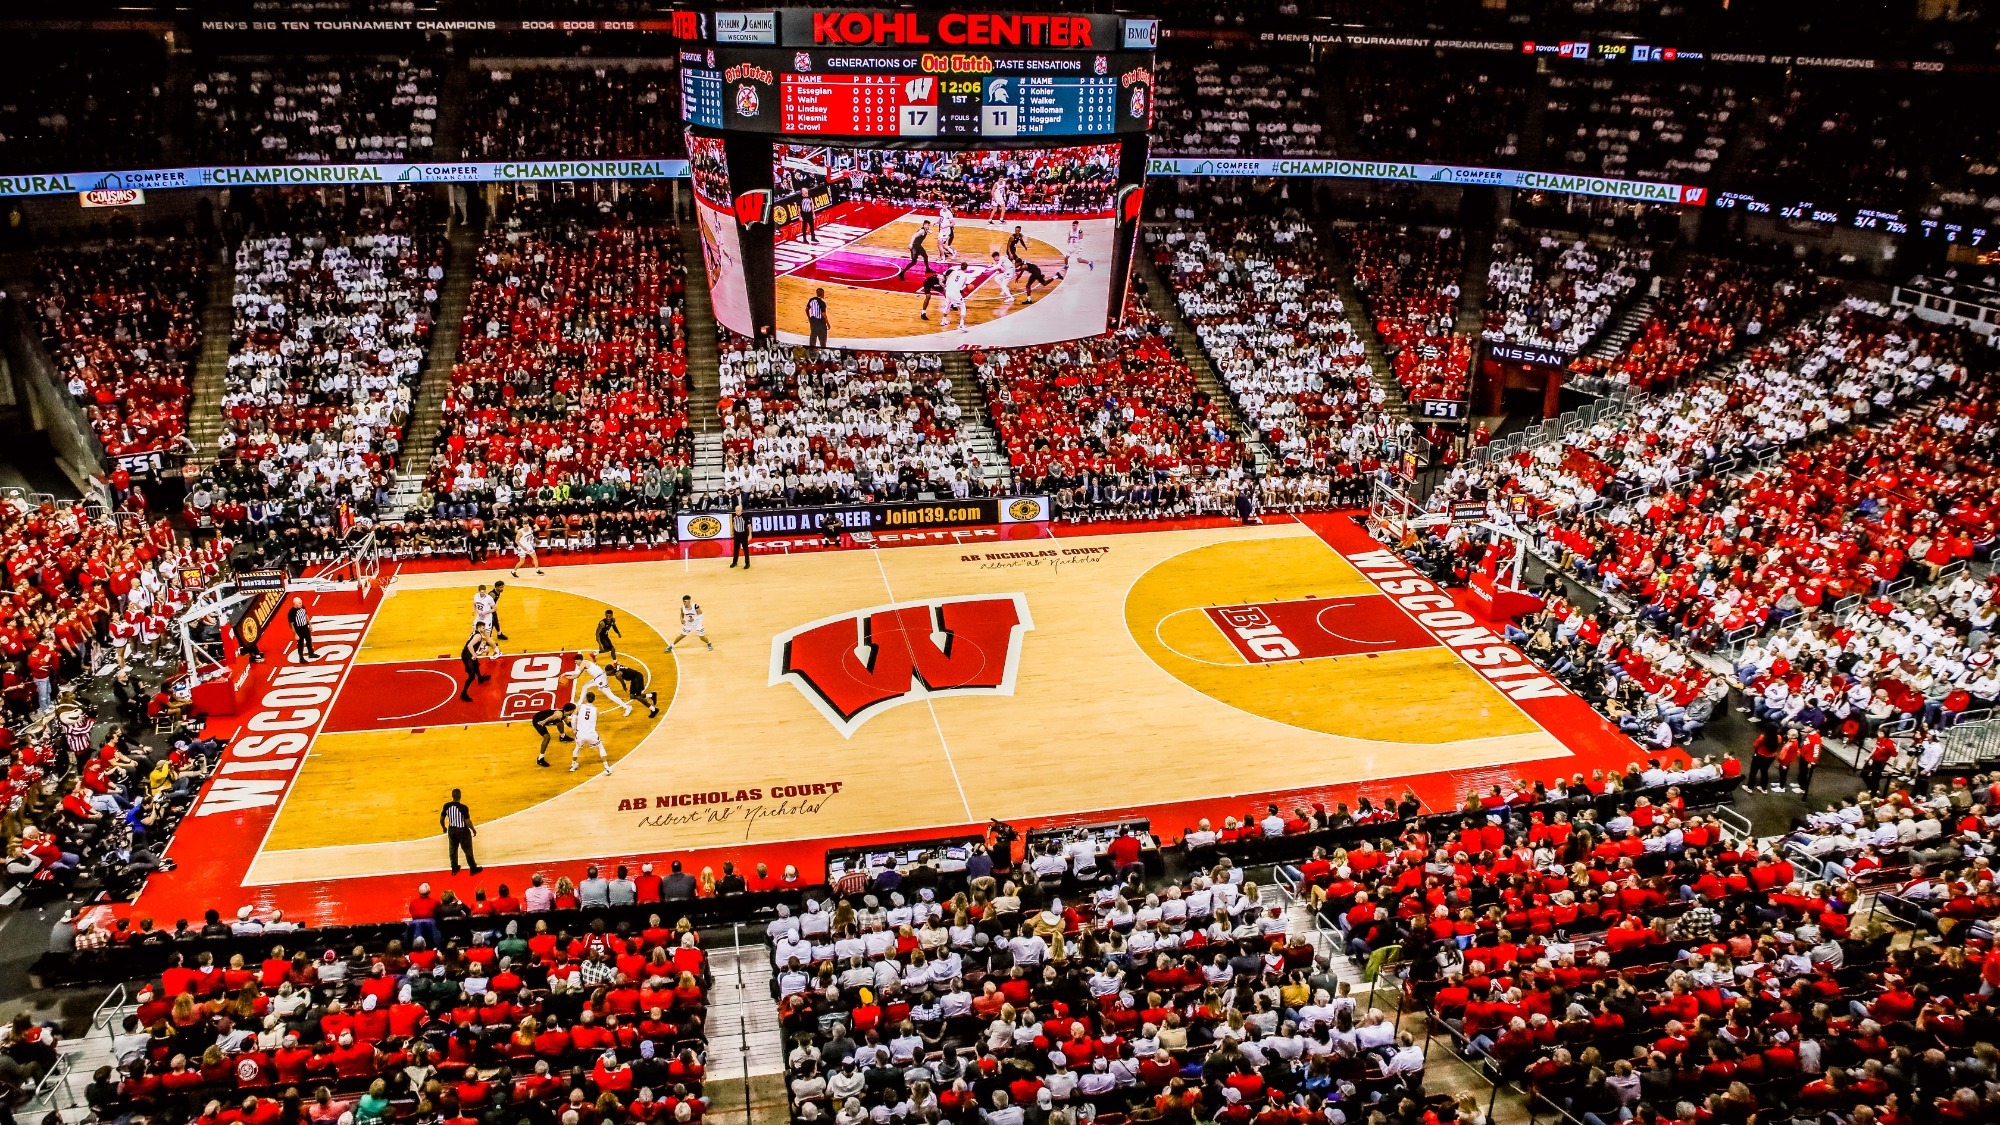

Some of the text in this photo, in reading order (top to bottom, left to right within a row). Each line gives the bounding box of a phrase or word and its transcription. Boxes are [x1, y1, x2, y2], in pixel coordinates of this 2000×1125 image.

[202, 21, 248, 30] MEN'S
[253, 21, 277, 30] BIG
[281, 21, 309, 30] TEN
[314, 21, 412, 30] TOURNAMENT
[416, 21, 496, 30] CHAMPIONS
[522, 21, 554, 30] 2004
[605, 21, 634, 30] 2015
[749, 19, 772, 30] GAMING
[814, 12, 1092, 47] KOHL CENTER
[1128, 27, 1148, 40] BMO
[1278, 33, 1309, 42] MEN'S
[1312, 34, 1342, 43] NCAA
[1347, 36, 1430, 47] TOURNAMENT
[1434, 40, 1514, 50] APPEARANCES
[1575, 46, 1587, 55] 17
[1598, 44, 1626, 54] 12:06
[1637, 48, 1647, 57] 11
[827, 58, 900, 69] GENERATIONS
[903, 58, 917, 68] OF
[995, 60, 1026, 70] TASTE
[1027, 60, 1081, 70] SENSATIONS
[1710, 53, 1766, 63] WOMEN'S
[1796, 57, 1875, 69] CHAMPIONS
[797, 75, 822, 83] NAME
[1031, 77, 1053, 85] NAME
[940, 82, 981, 93] 12:06
[1030, 87, 1054, 95] Kohler
[797, 96, 818, 104] Wahl
[1030, 97, 1056, 105] Walker
[797, 105, 828, 114] Lindsey
[1030, 106, 1064, 114] Holloman
[907, 110, 928, 126] 17
[992, 110, 1008, 126] 11
[1029, 115, 1062, 124] Hoggard
[797, 123, 821, 131] Crowl
[1029, 124, 1043, 132] Hall
[425, 166, 478, 175] COMPEER
[493, 162, 665, 178] #CHAMPIONRURAL
[1216, 162, 1260, 170] COMPEER
[1271, 161, 1418, 178] #CHAMPIONRURAL
[126, 172, 185, 183] COMPEER
[203, 166, 383, 183] #CHAMPIONRURAL
[1456, 170, 1503, 179] COMPEER
[0, 176, 76, 194] RURAL
[1515, 173, 1678, 200] #CHAMPIONRURAL
[90, 190, 134, 202] COUSINS
[1716, 197, 1770, 213] 6/9 67%
[1780, 207, 1838, 222] 2/4 50%
[1858, 209, 1875, 217] FREE
[1853, 216, 1908, 234] 3/4 75%
[1924, 228, 1982, 246] 1 6 7
[1493, 347, 1562, 365] NISSAN
[1424, 401, 1458, 417] FS1
[118, 453, 161, 473] FS1
[752, 506, 981, 532] BUILD A CREER Join139.com
[877, 529, 998, 542] ENTER
[985, 549, 1057, 561] NICHOLAS
[1061, 546, 1110, 556] COURT
[1346, 549, 1569, 700] WISCONSIN
[778, 596, 1028, 730] W
[585, 711, 590, 720] 5
[618, 781, 843, 811] AB NICHOLAS COURT
